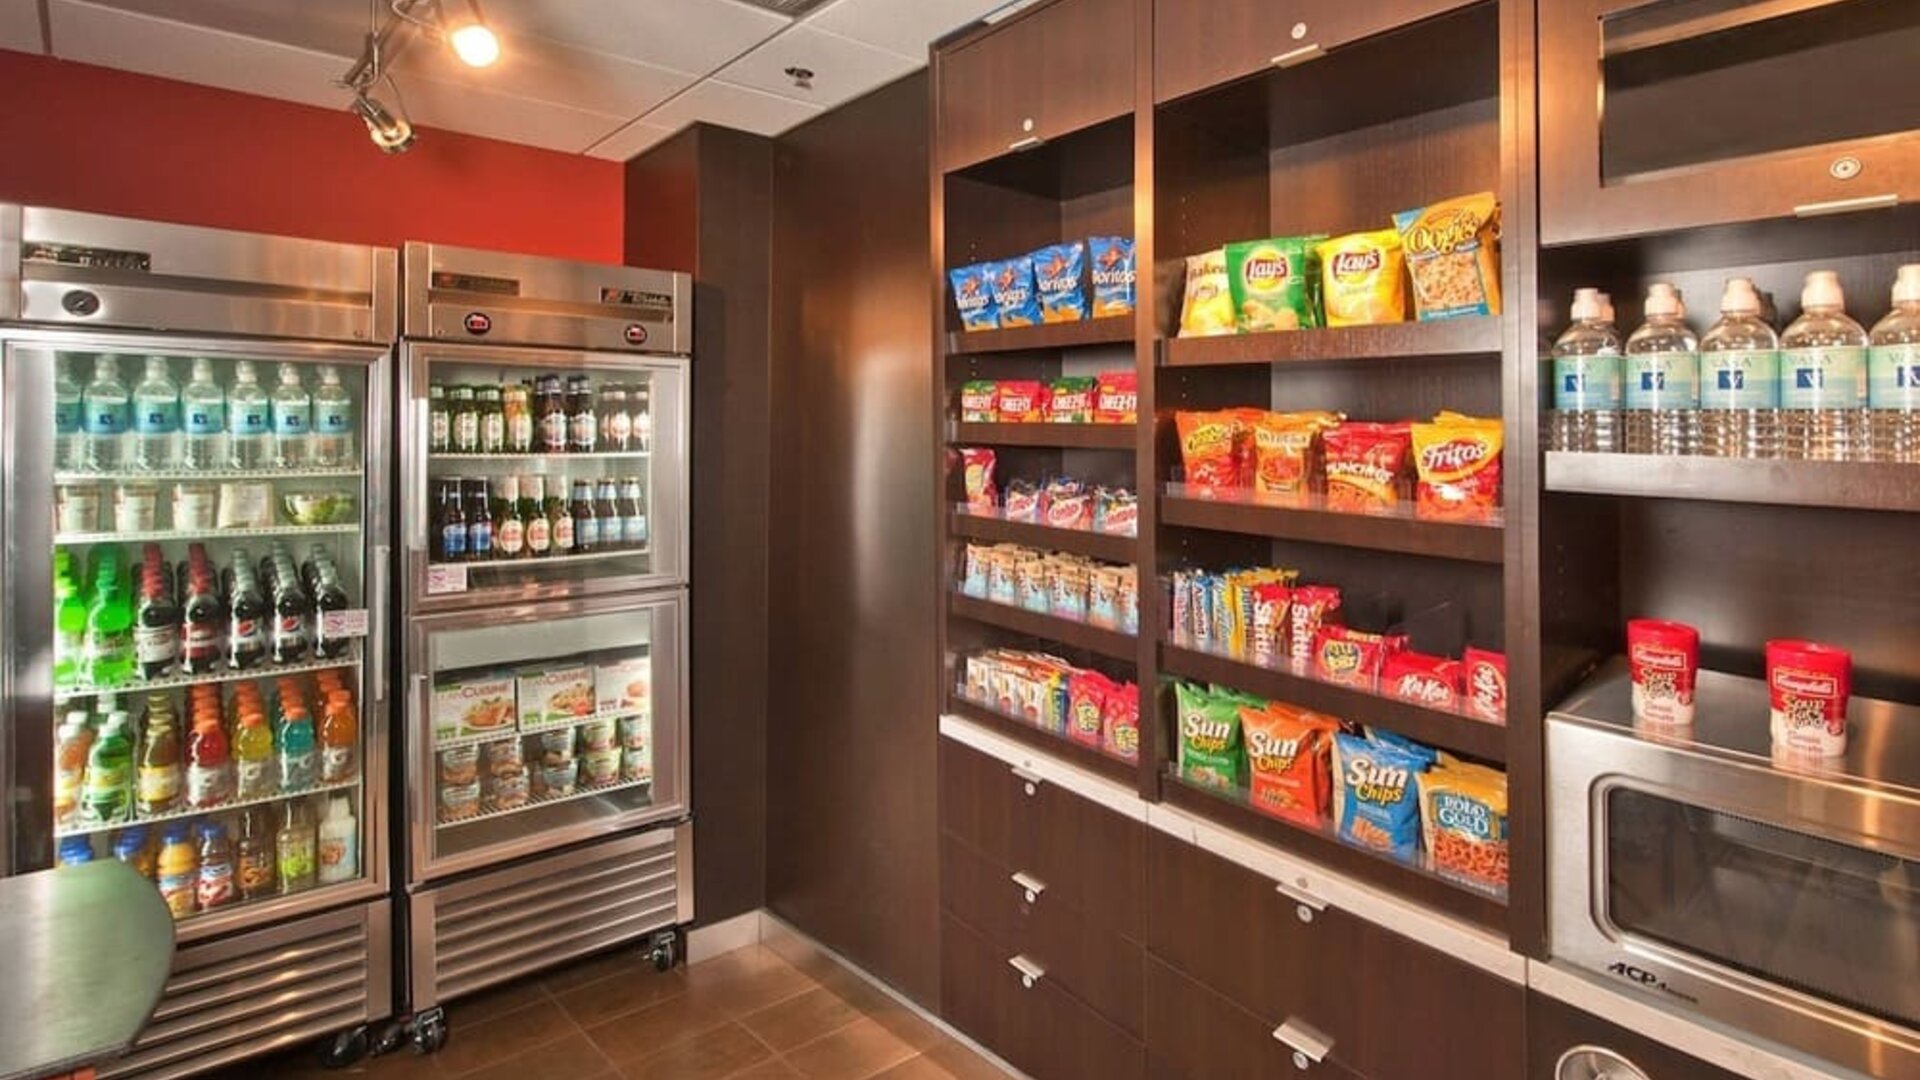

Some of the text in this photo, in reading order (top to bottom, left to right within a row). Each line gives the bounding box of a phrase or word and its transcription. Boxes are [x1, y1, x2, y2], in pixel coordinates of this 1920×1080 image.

[1423, 440, 1487, 469] Fritos
[1184, 714, 1231, 739] Sun
[1250, 731, 1298, 759] Sun
[1345, 758, 1408, 788] Sun
[1355, 782, 1404, 806] Chips
[1607, 961, 1657, 988] ACP
